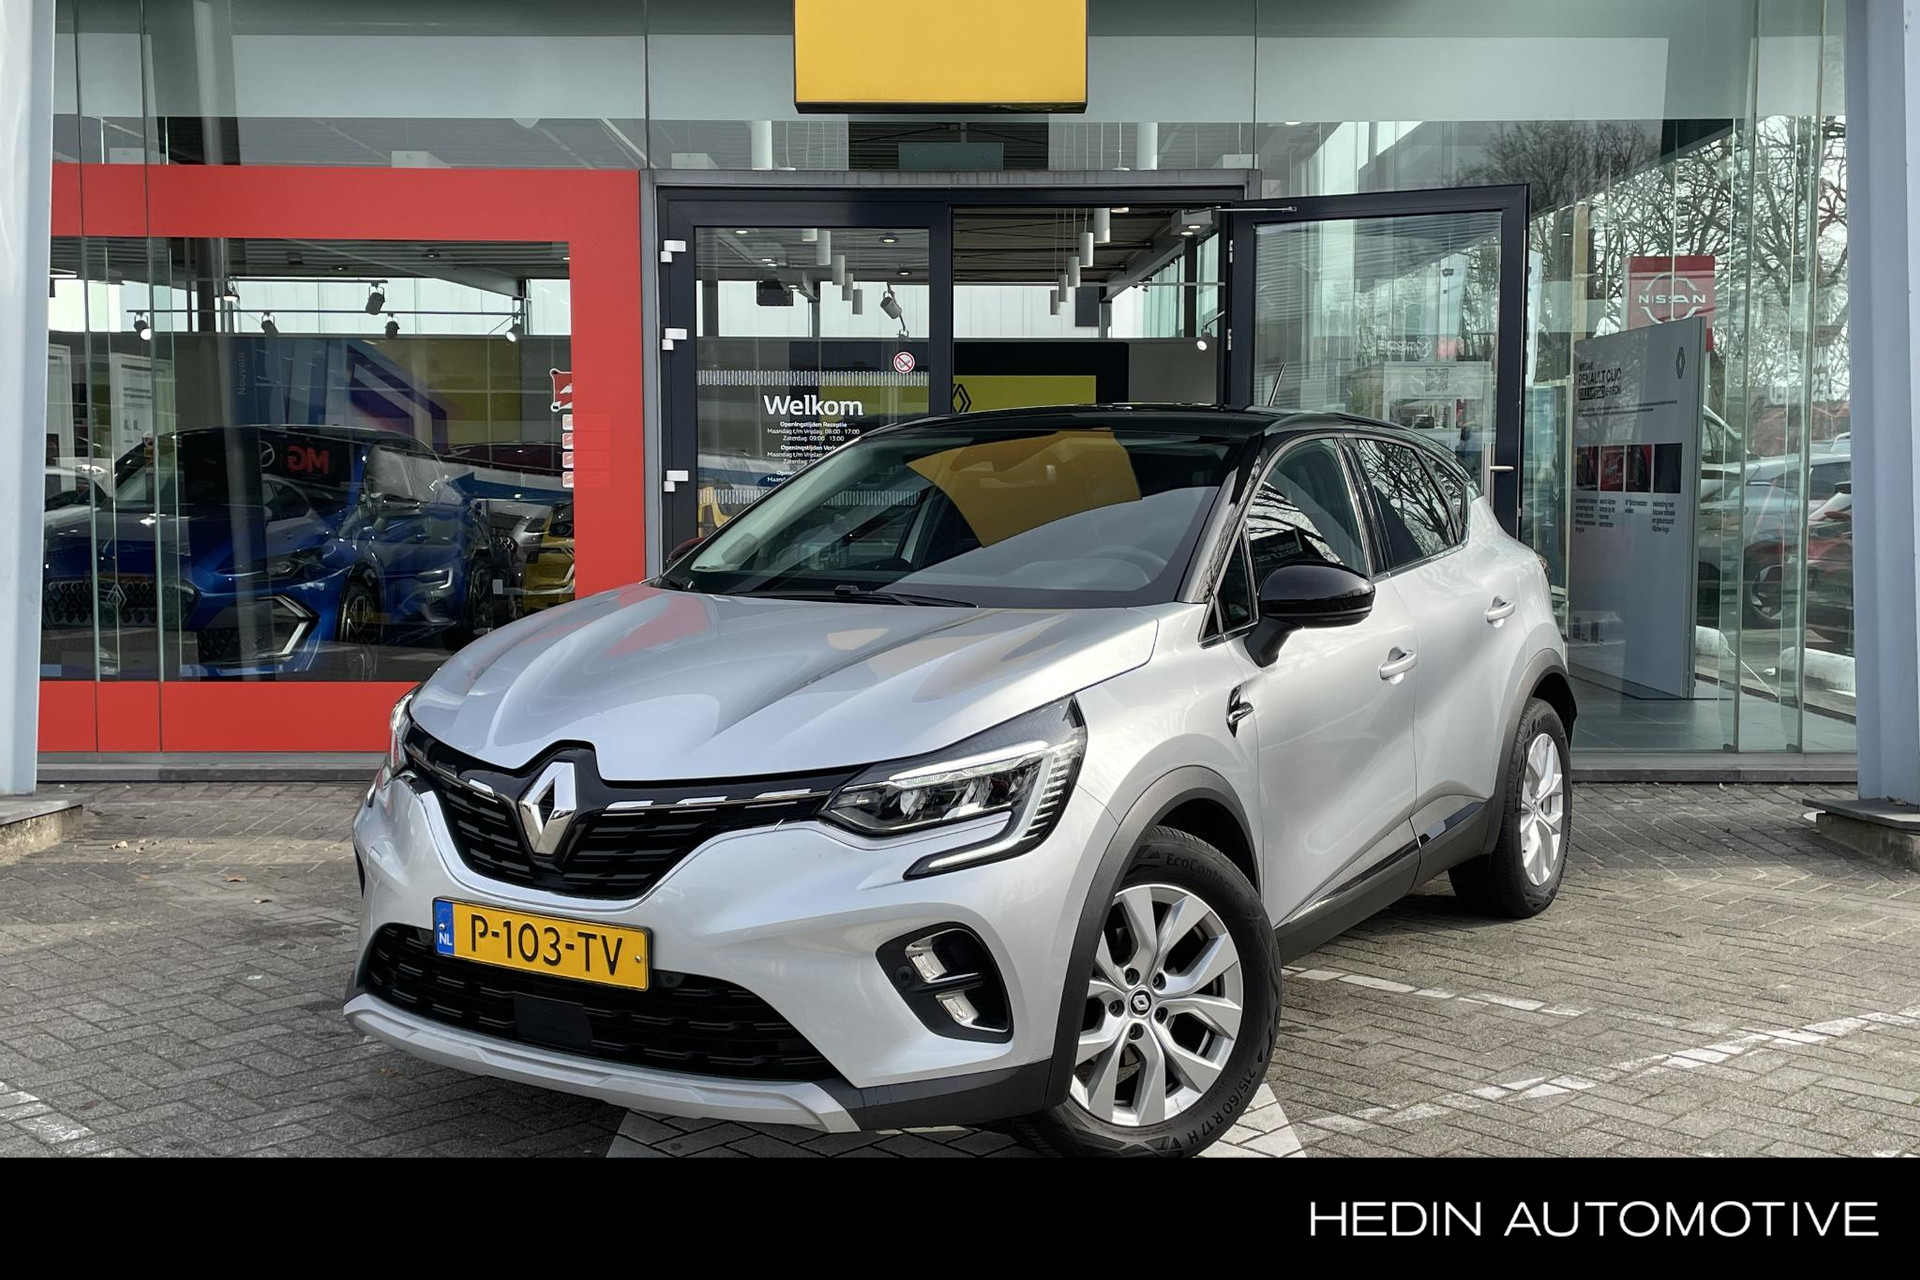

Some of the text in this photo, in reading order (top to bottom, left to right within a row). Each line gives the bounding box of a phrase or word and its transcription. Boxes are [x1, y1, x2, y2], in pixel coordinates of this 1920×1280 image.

[763, 394, 864, 416] Welkom
[439, 932, 453, 946] NL
[470, 914, 623, 976] P-103-TV
[1187, 1067, 1256, 1144] 215/60 R 17 H
